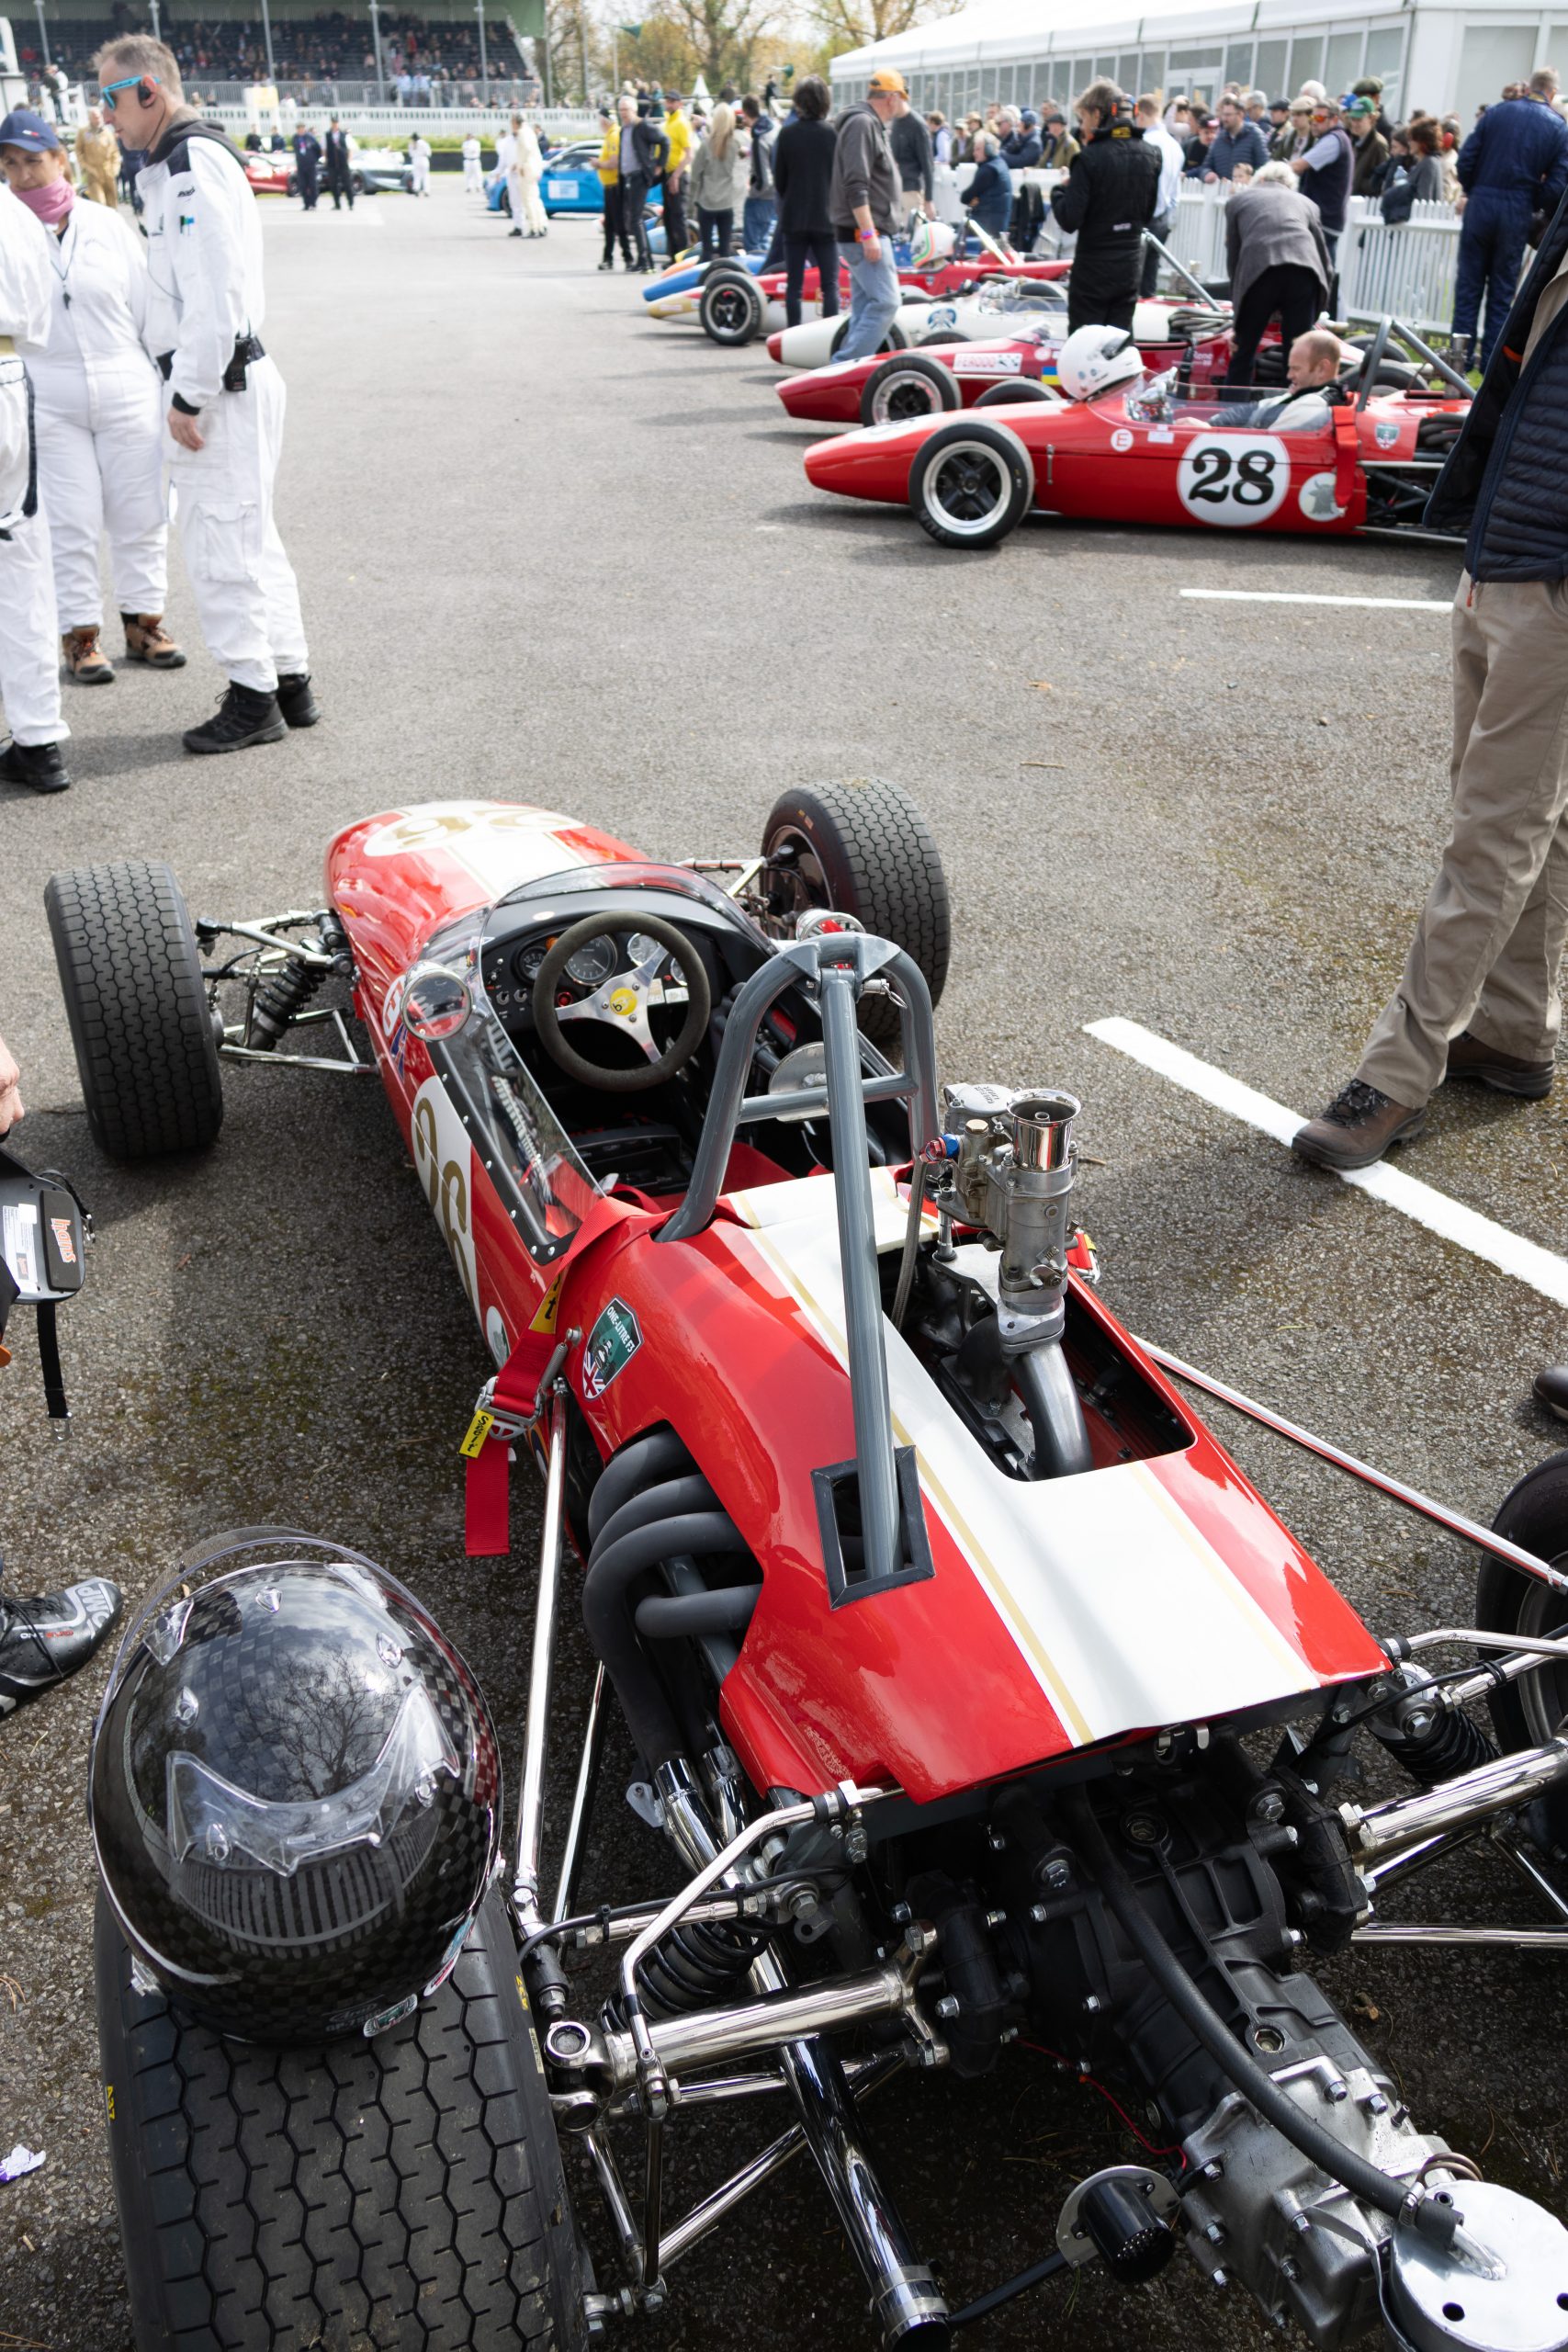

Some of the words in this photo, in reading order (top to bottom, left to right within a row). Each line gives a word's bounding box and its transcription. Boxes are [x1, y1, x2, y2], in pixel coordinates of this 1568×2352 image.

[1116, 433, 1130, 447] E
[1188, 447, 1276, 505] 28
[50, 1217, 77, 1263] hans
[606, 1306, 630, 1345] ONE-LITRE
[625, 1340, 636, 1353] F3
